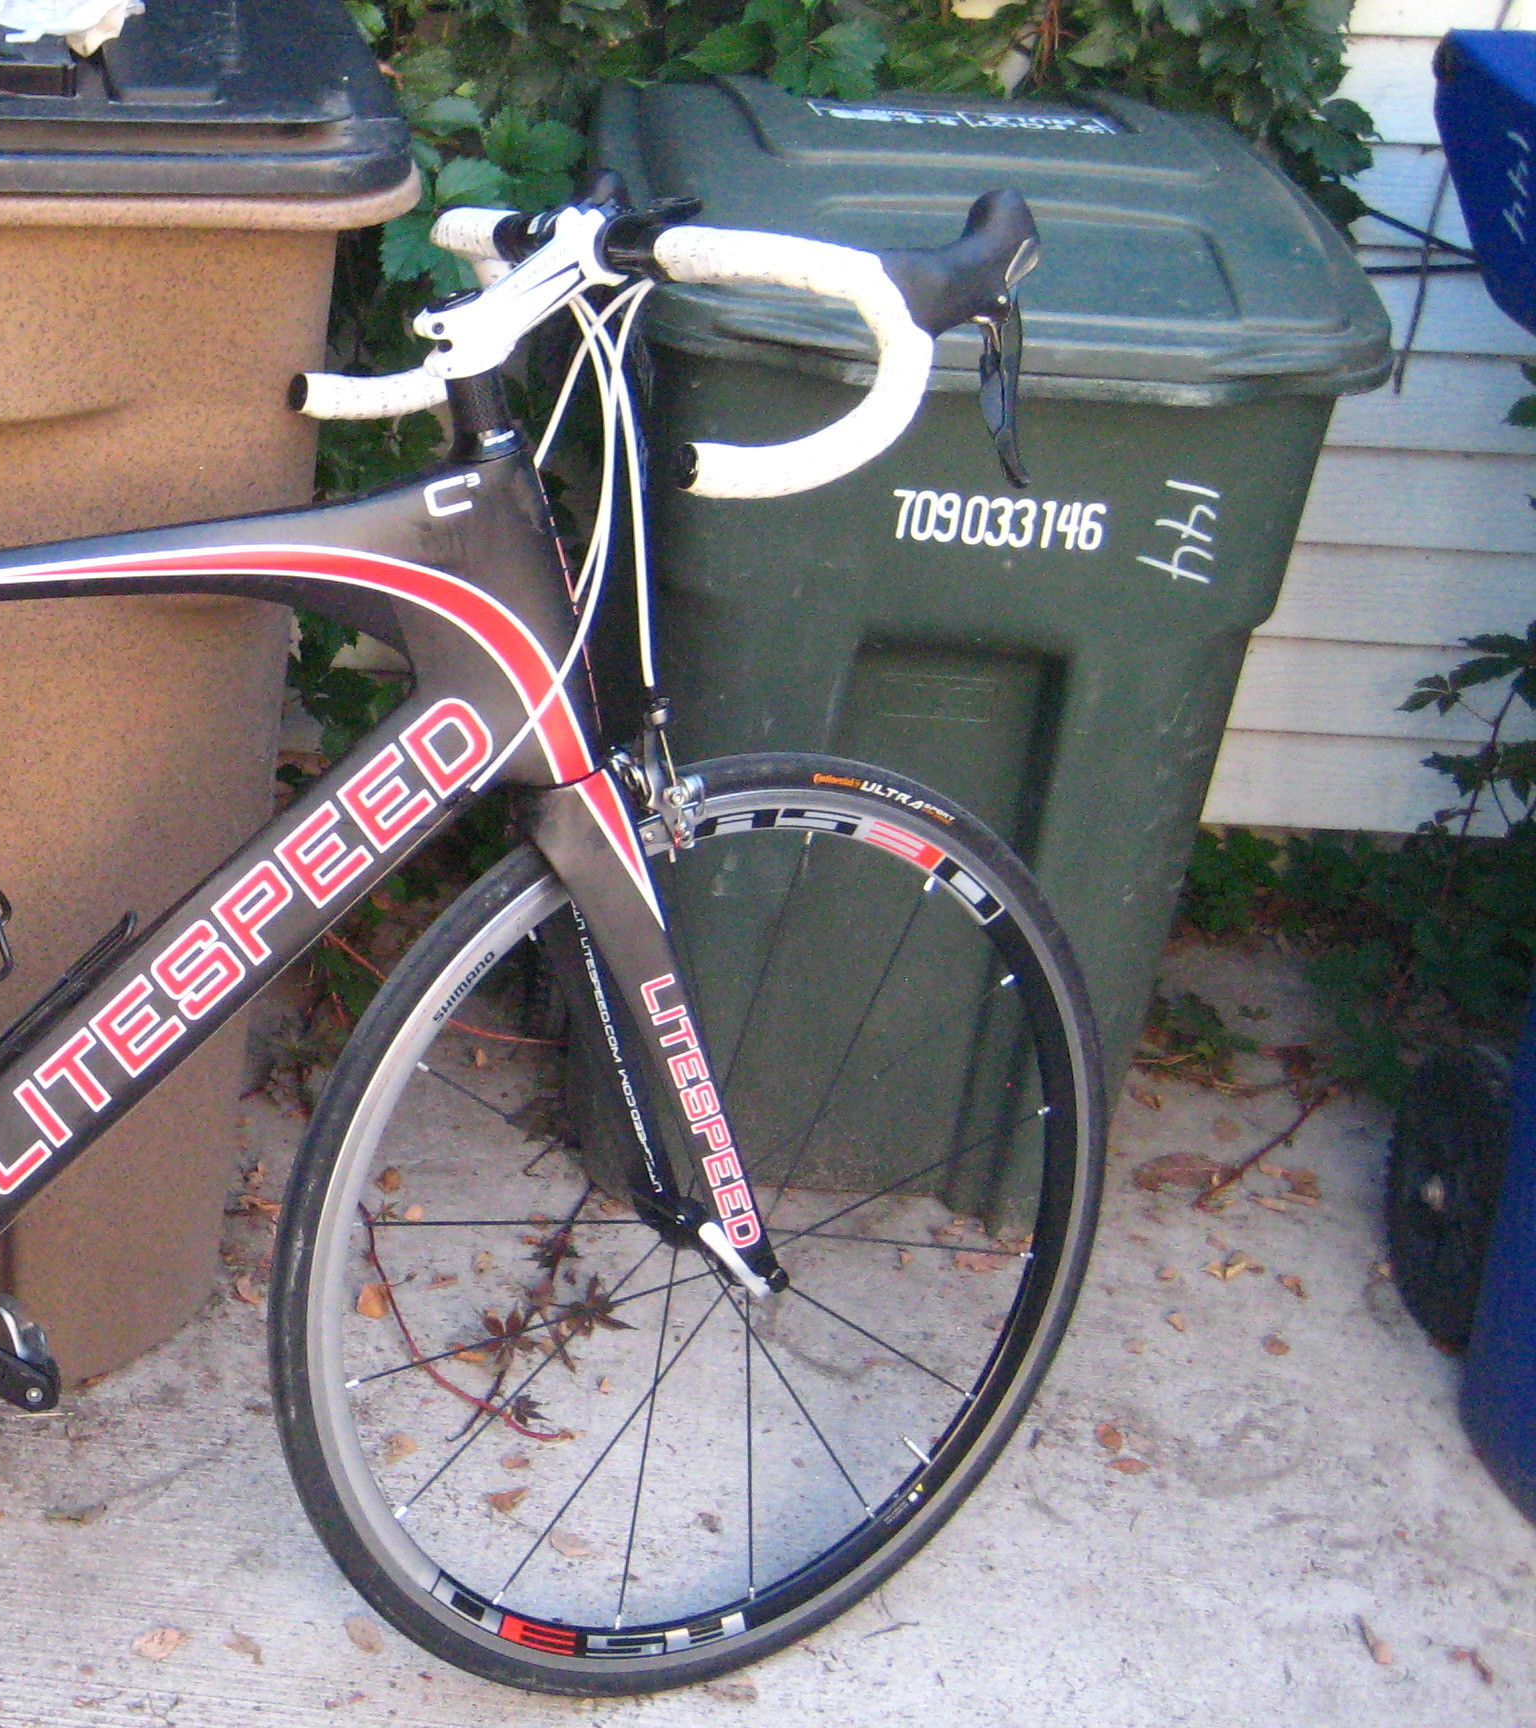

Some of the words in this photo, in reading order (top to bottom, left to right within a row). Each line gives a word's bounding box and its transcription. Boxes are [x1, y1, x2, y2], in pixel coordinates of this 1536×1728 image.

[893, 488, 1107, 551] 709033146
[1135, 480, 1221, 584] 144
[860, 780, 925, 810] ULTRA
[922, 803, 957, 821] SPORT
[431, 949, 496, 1023] SHIMANO
[640, 973, 762, 1249] LITESPEED
